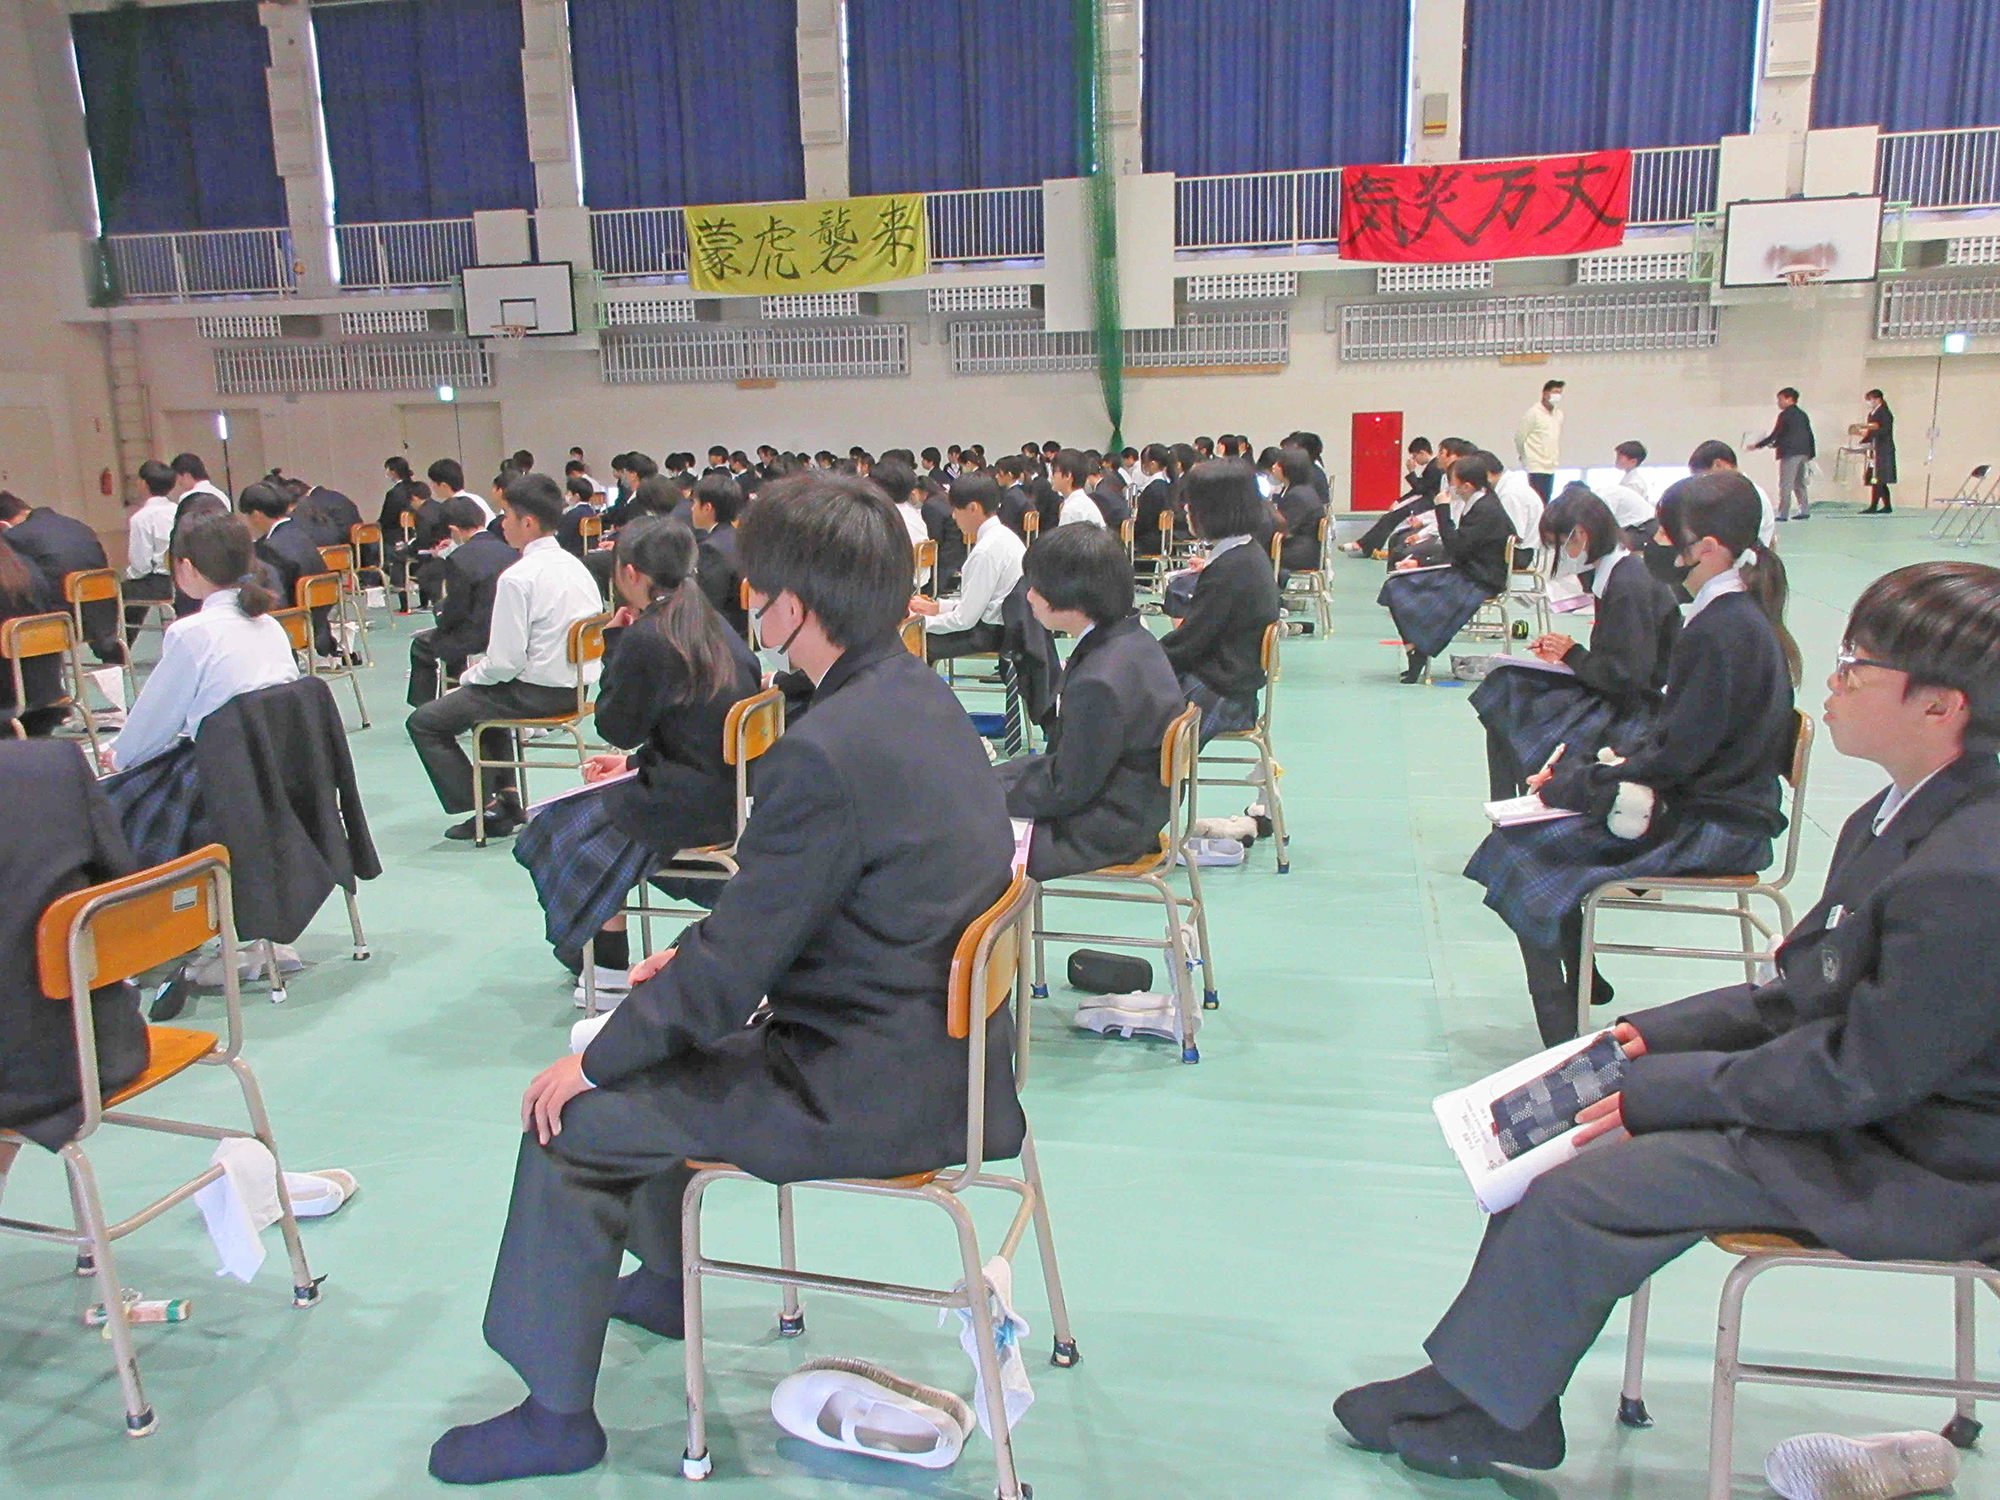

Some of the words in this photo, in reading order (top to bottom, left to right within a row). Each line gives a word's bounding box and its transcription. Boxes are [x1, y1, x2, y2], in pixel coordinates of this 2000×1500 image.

[696, 198, 915, 280] 蒙虎襲来
[1340, 159, 1624, 247] 気炎万丈
